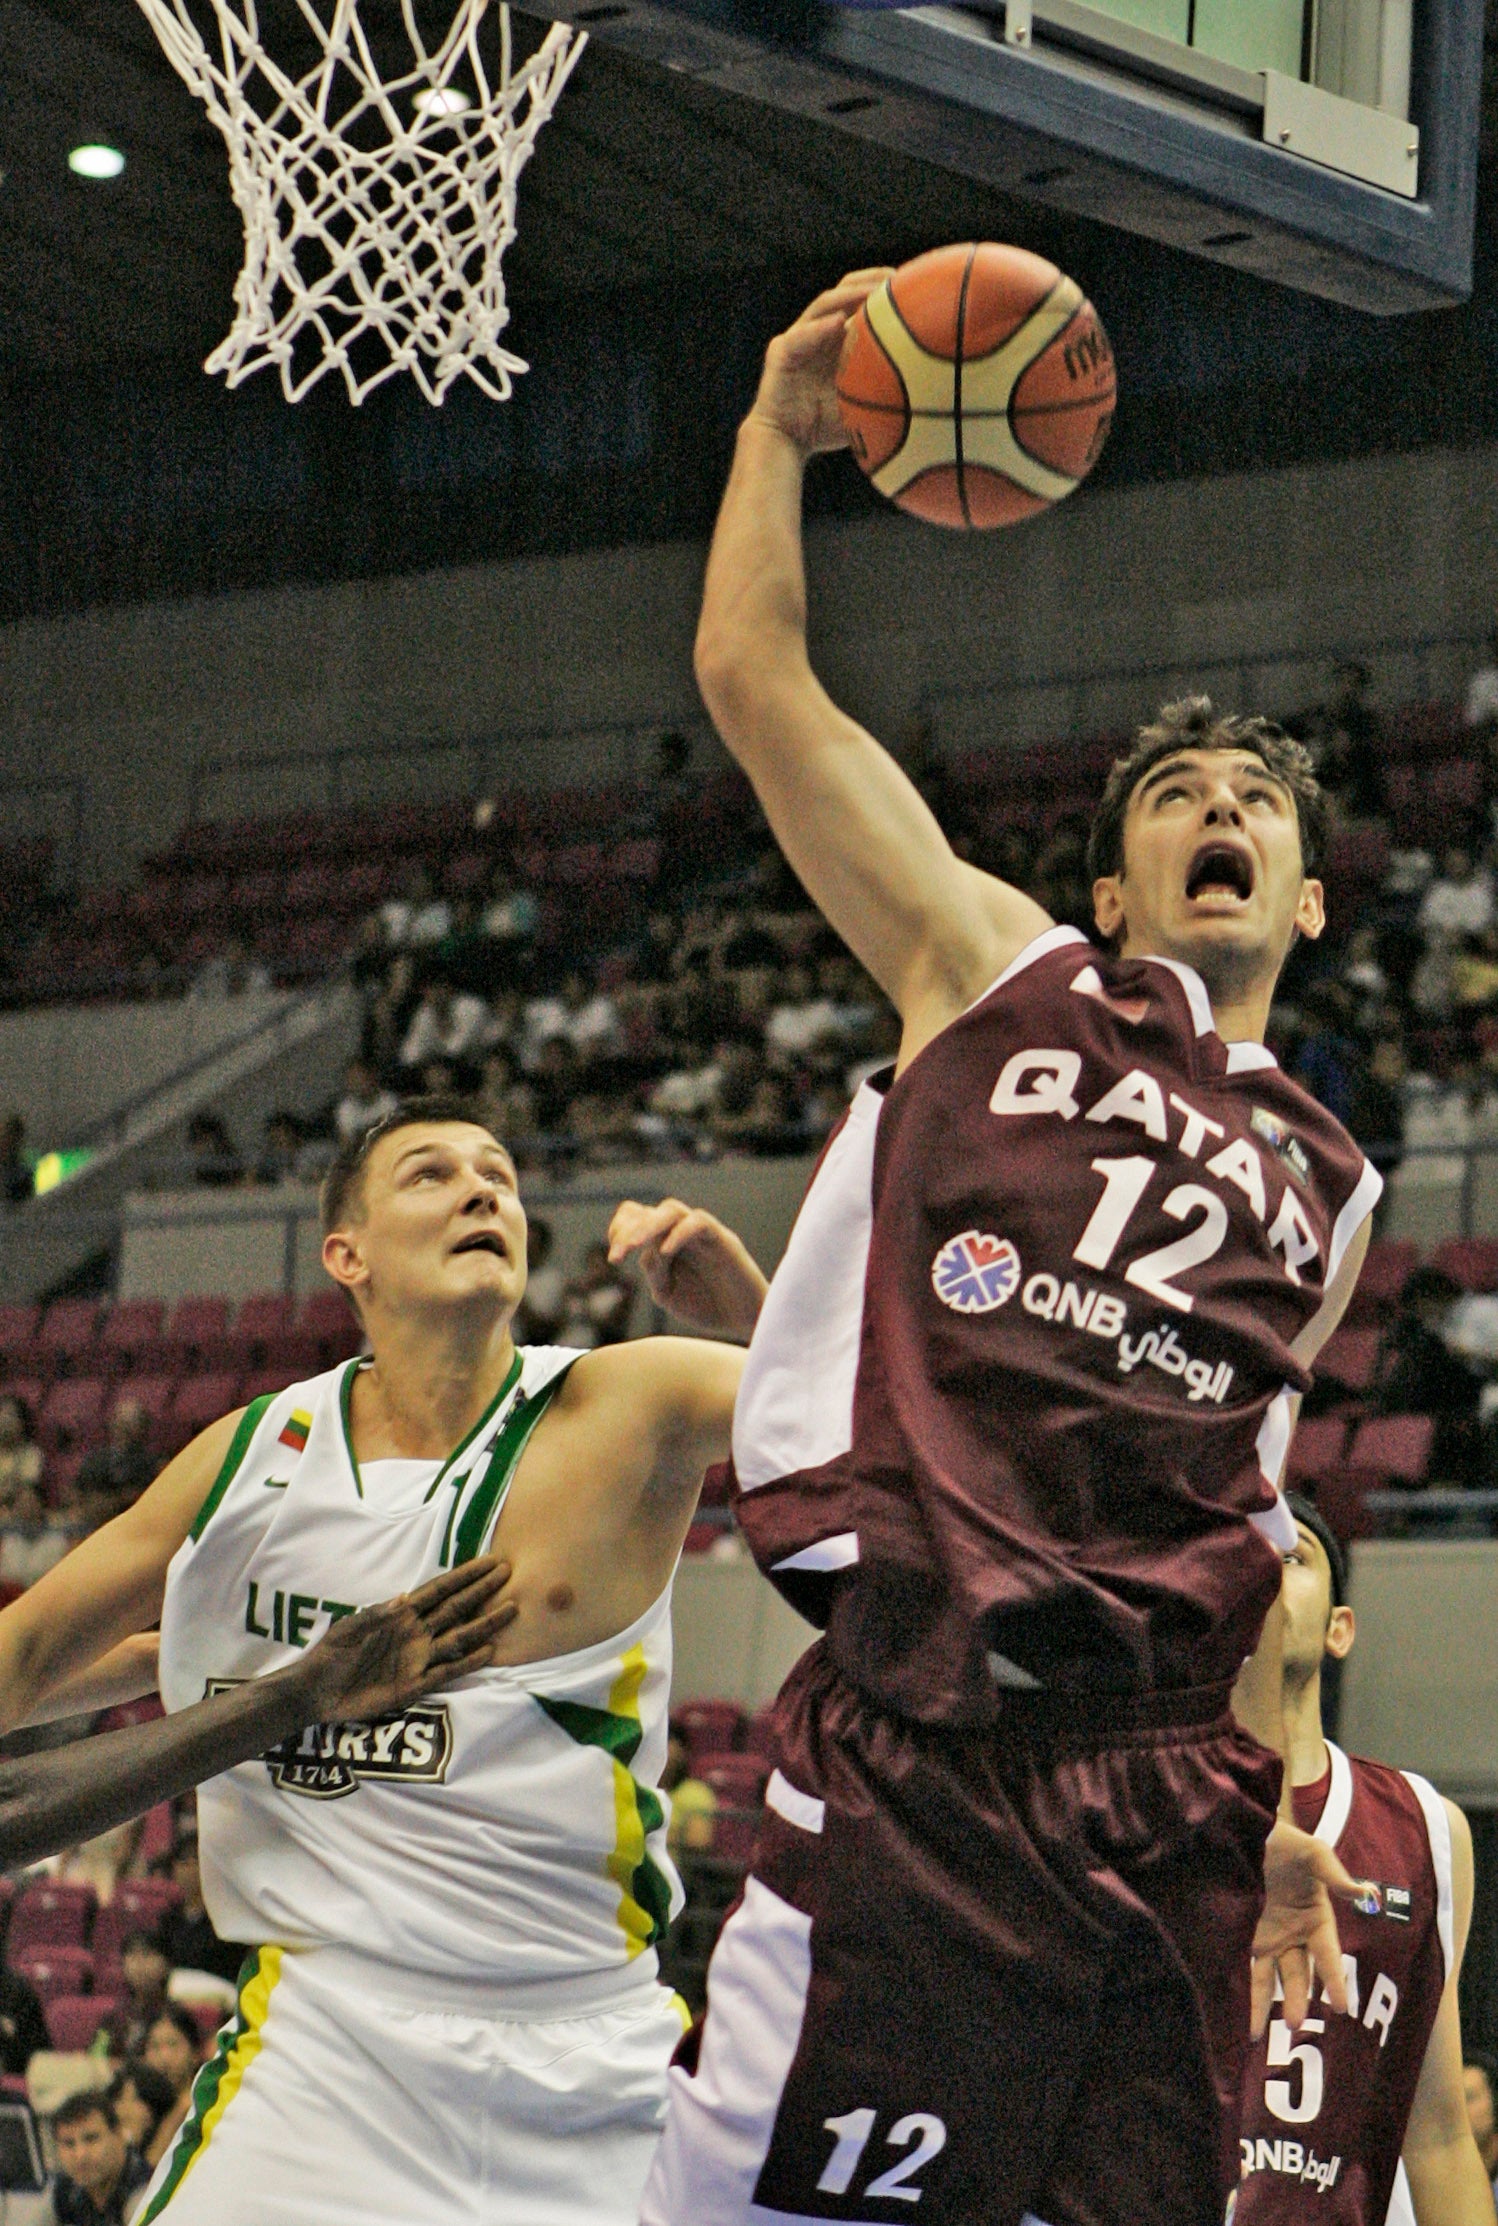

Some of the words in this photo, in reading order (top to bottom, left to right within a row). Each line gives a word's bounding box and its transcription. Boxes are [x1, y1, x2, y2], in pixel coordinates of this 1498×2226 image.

[989, 1048, 1319, 1287] QATAR
[1072, 1155, 1229, 1314] 12
[1022, 1273, 1128, 1338] QNB
[1264, 2017, 1325, 2124] 5
[815, 2107, 947, 2202] 12
